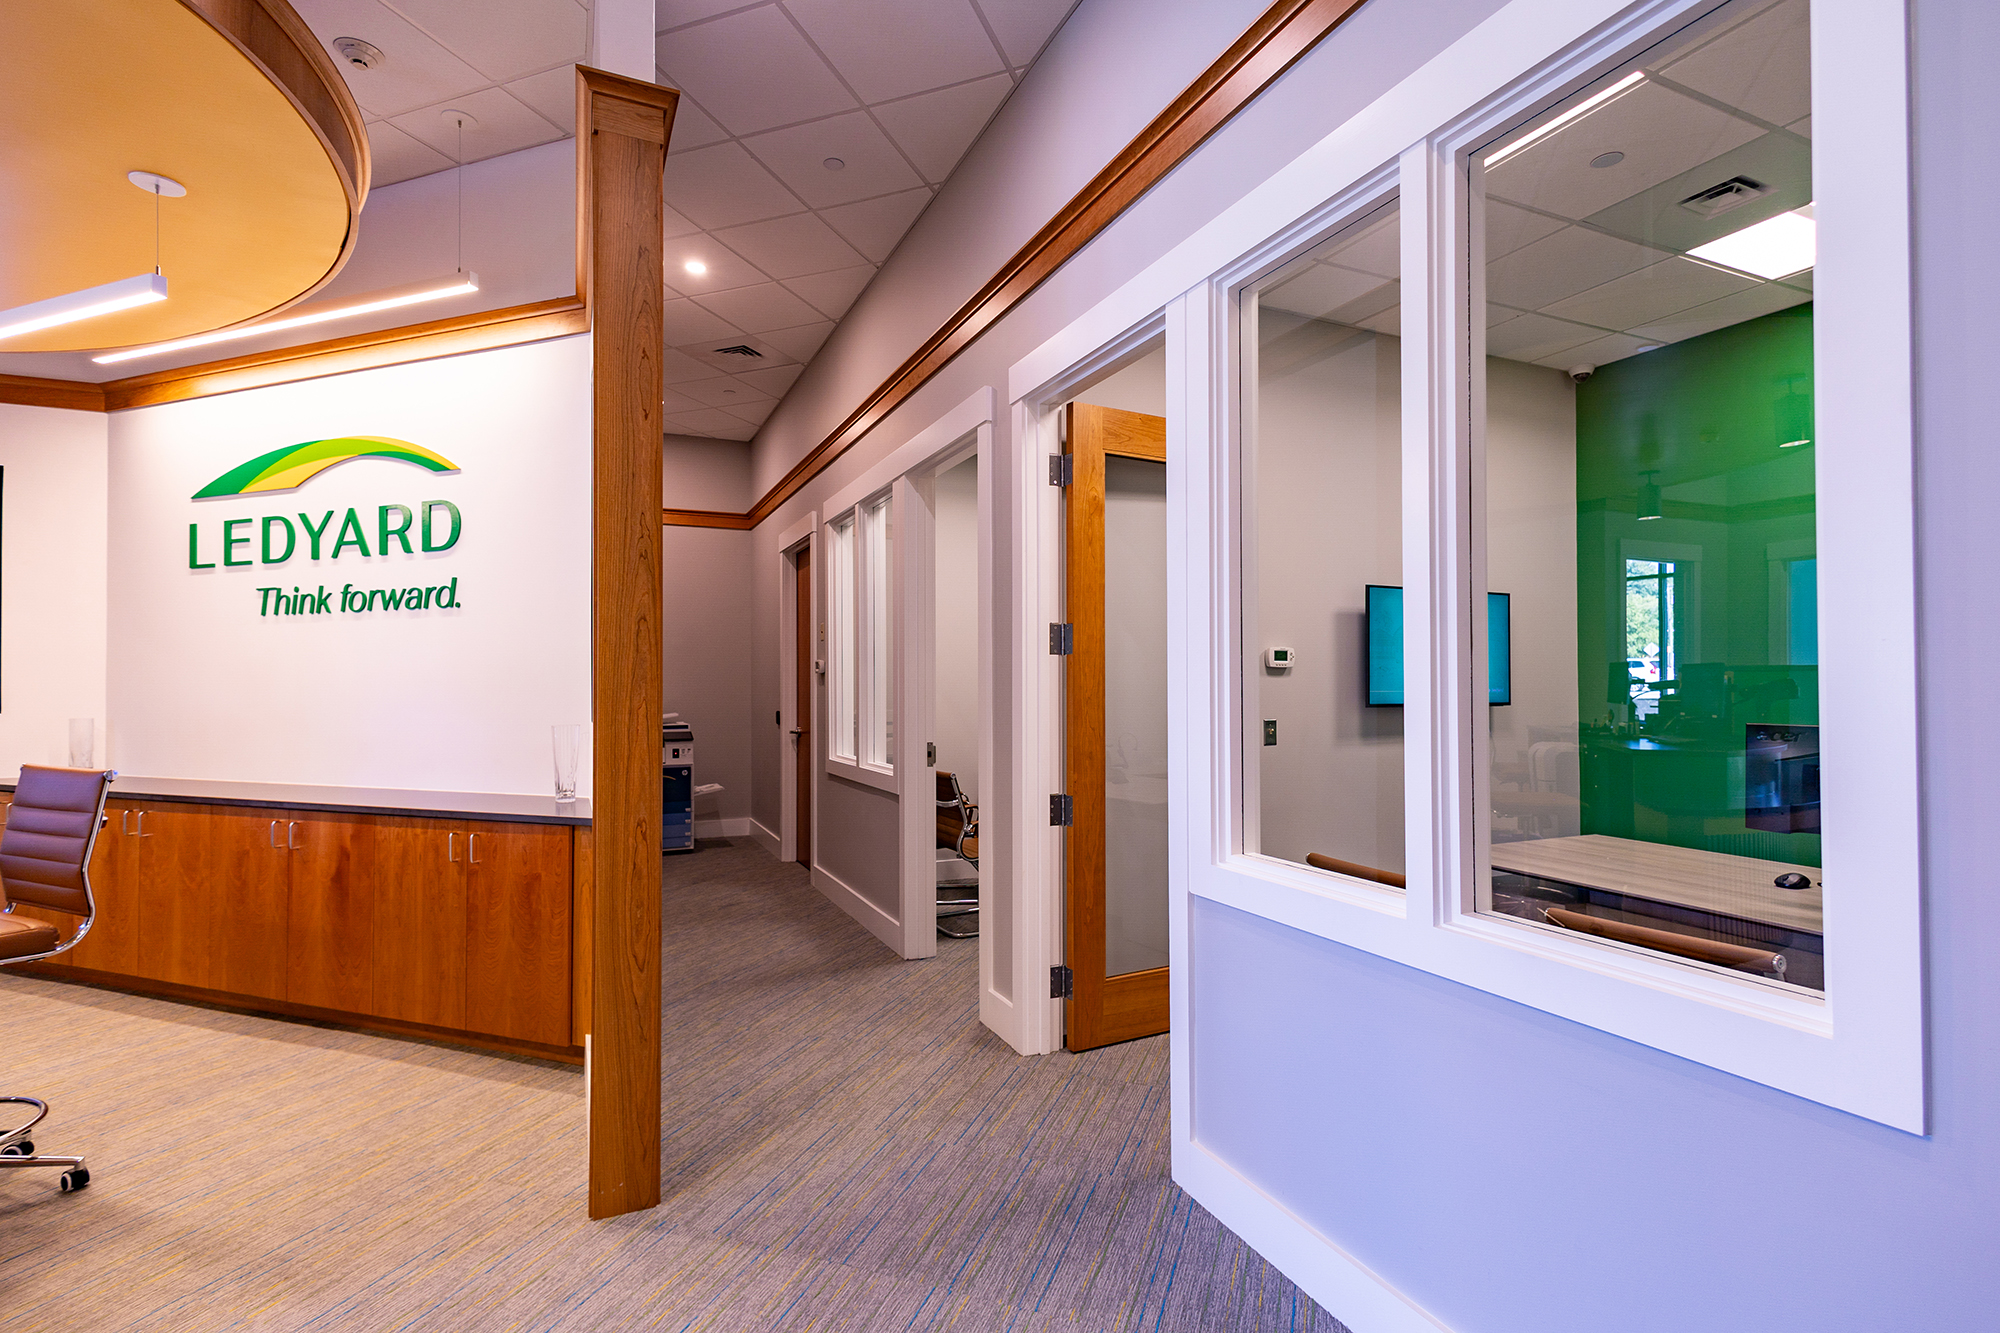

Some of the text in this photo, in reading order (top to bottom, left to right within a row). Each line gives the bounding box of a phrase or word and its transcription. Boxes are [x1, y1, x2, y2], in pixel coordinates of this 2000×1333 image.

[189, 499, 462, 569] LEDYARD
[256, 577, 461, 616] Think forward.
